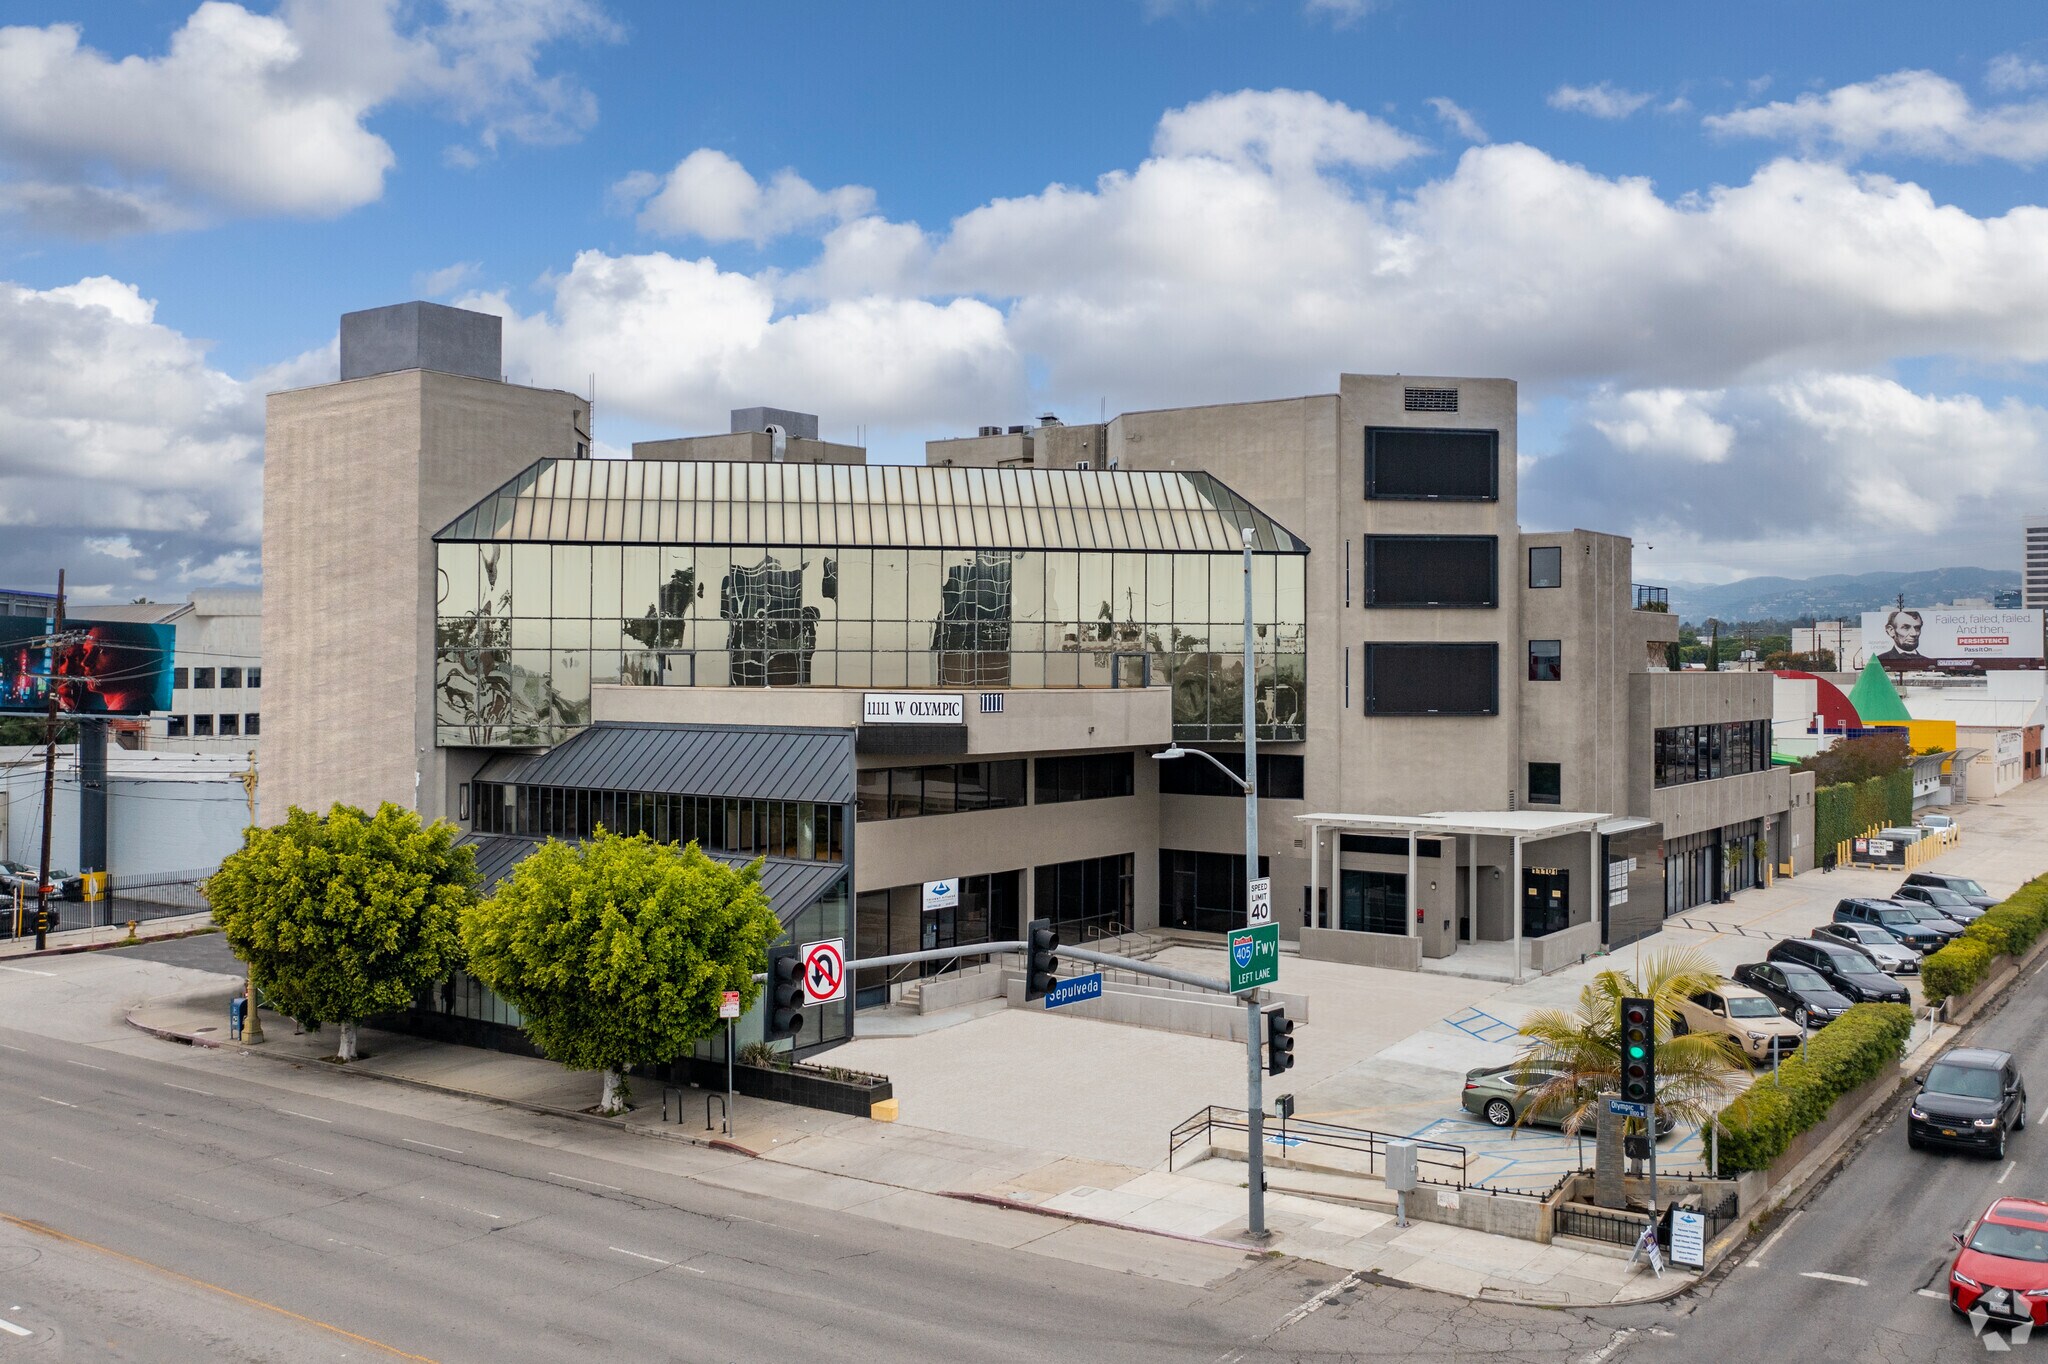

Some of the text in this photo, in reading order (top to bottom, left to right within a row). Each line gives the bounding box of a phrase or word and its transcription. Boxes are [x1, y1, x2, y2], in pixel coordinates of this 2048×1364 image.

[1935, 613, 2033, 625] Failed, failed, failed.
[1956, 625, 2011, 634] And then...
[867, 701, 960, 717] 11111 W OLYMPIC
[1251, 882, 1268, 892] SPEED
[1251, 892, 1267, 902] LIMIT
[1251, 902, 1268, 920] 40
[1236, 946, 1251, 960] 405
[1255, 940, 1276, 957] Fwy
[1238, 967, 1271, 985] LEFT LANE
[1049, 980, 1099, 1002] Sepulveda
[1610, 1101, 1634, 1111] Olympic
